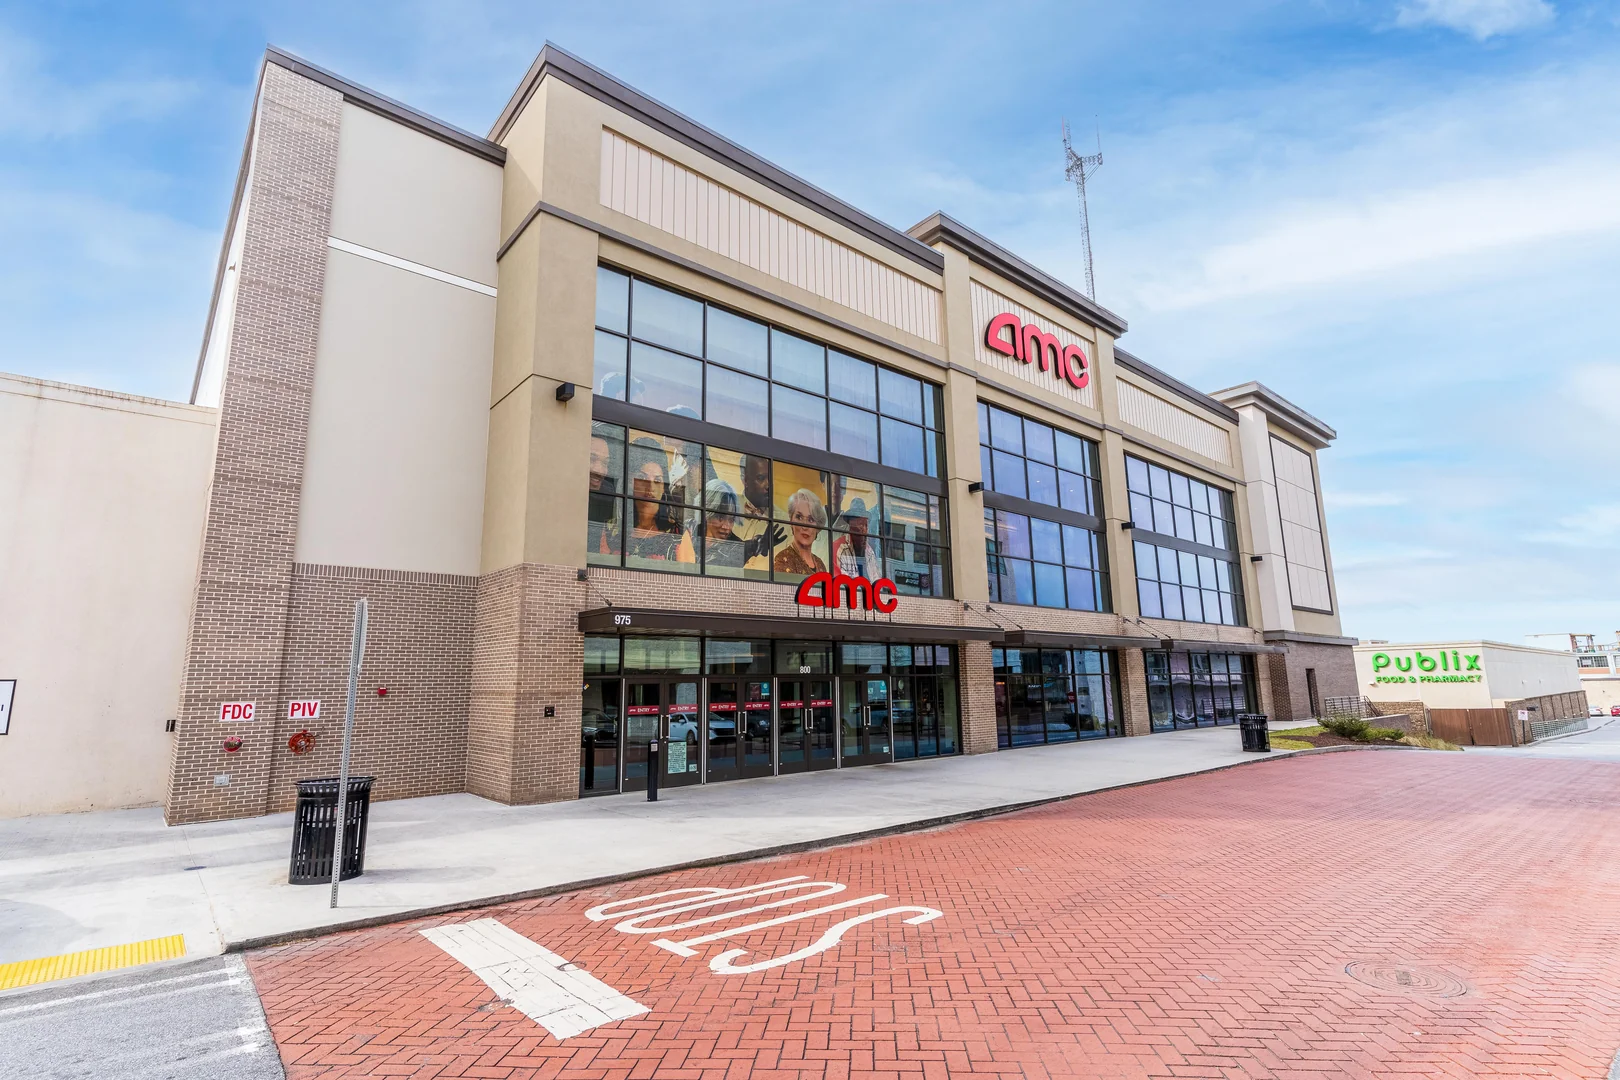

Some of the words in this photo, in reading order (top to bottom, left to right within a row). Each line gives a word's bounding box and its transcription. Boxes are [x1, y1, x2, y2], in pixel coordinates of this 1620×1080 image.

[614, 614, 631, 625] 975
[1371, 650, 1481, 673] Publix
[799, 665, 811, 674] 800
[1375, 675, 1405, 683] FOOD
[1408, 675, 1417, 683] &
[1420, 675, 1482, 683] PHARMACY
[221, 703, 253, 720] FDC
[290, 701, 318, 717] PIV
